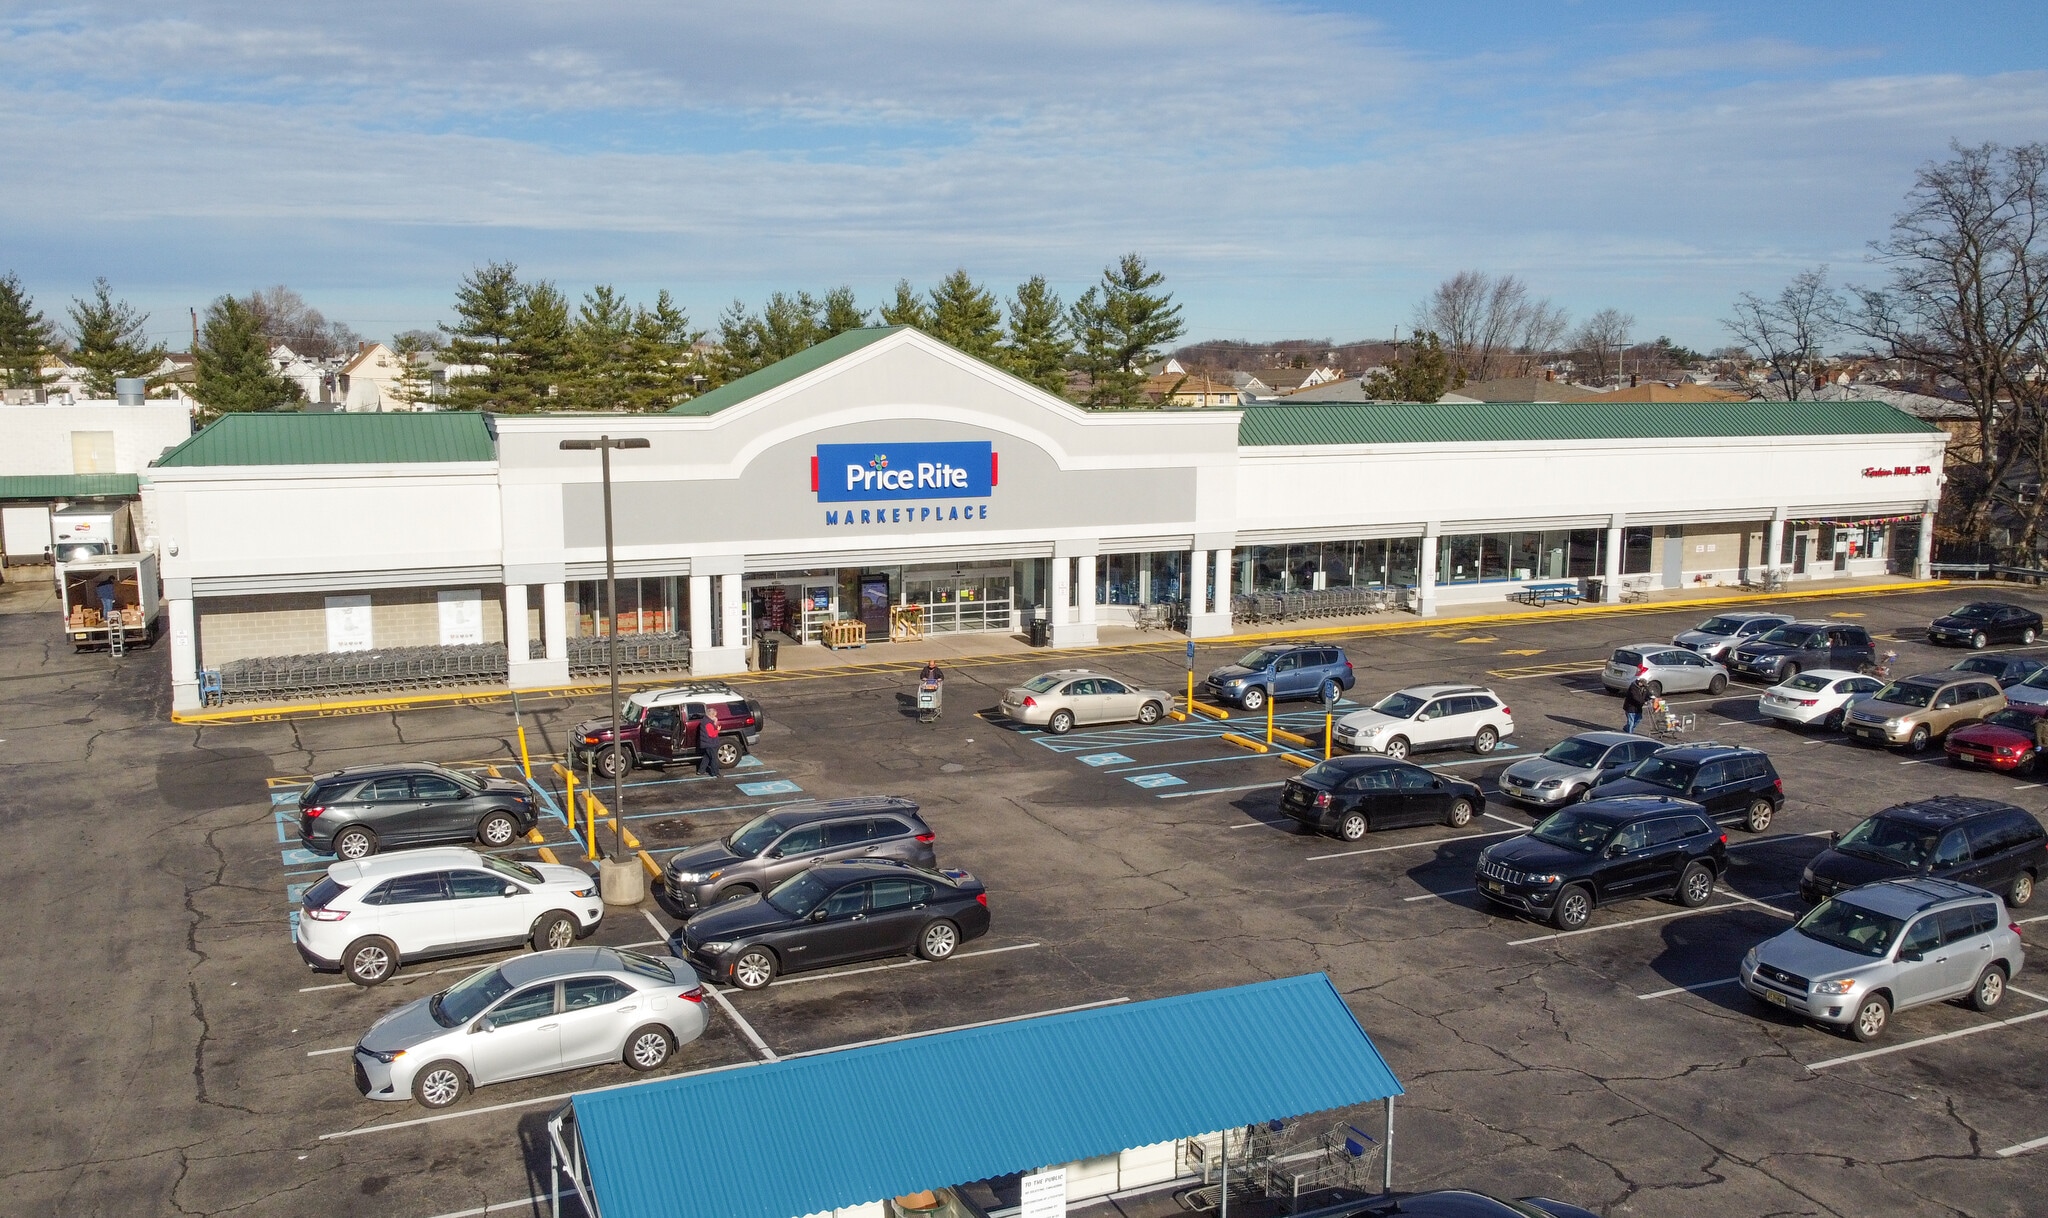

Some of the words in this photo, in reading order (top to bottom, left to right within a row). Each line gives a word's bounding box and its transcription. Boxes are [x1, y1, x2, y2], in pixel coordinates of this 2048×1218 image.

[846, 464, 914, 491] Price
[917, 462, 968, 489] Rite
[825, 504, 988, 526] MARKETPLACE
[252, 714, 281, 722] NO
[319, 703, 410, 717] PARKING
